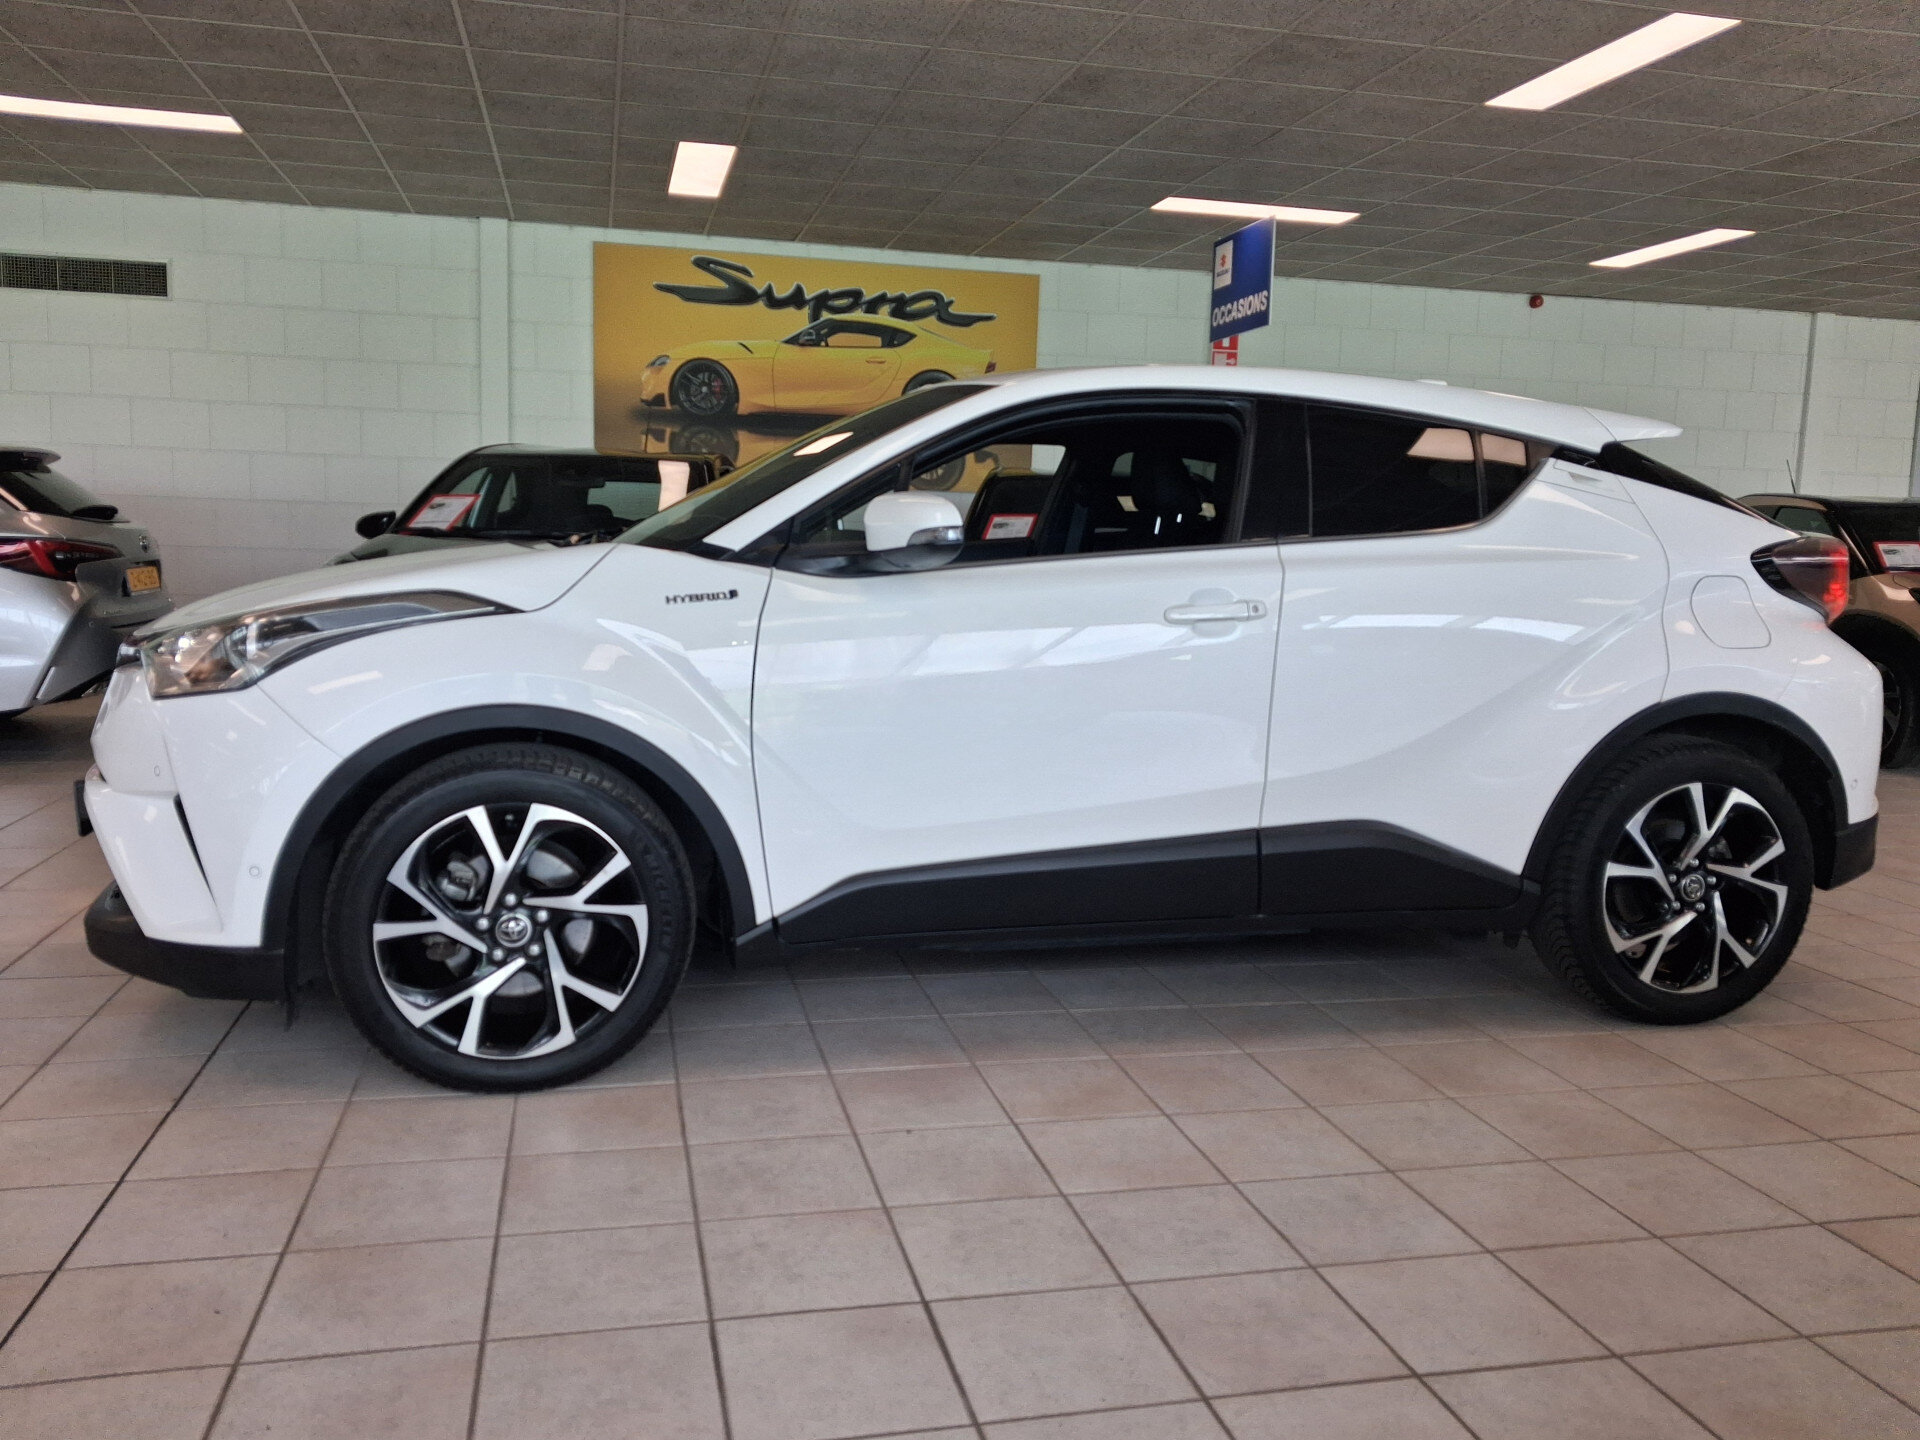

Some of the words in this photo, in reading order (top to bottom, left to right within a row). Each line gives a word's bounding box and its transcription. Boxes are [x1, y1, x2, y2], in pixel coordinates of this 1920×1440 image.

[653, 255, 997, 328] Supra
[1212, 290, 1268, 327] OCCASIONS
[665, 591, 727, 605] HYBRID
